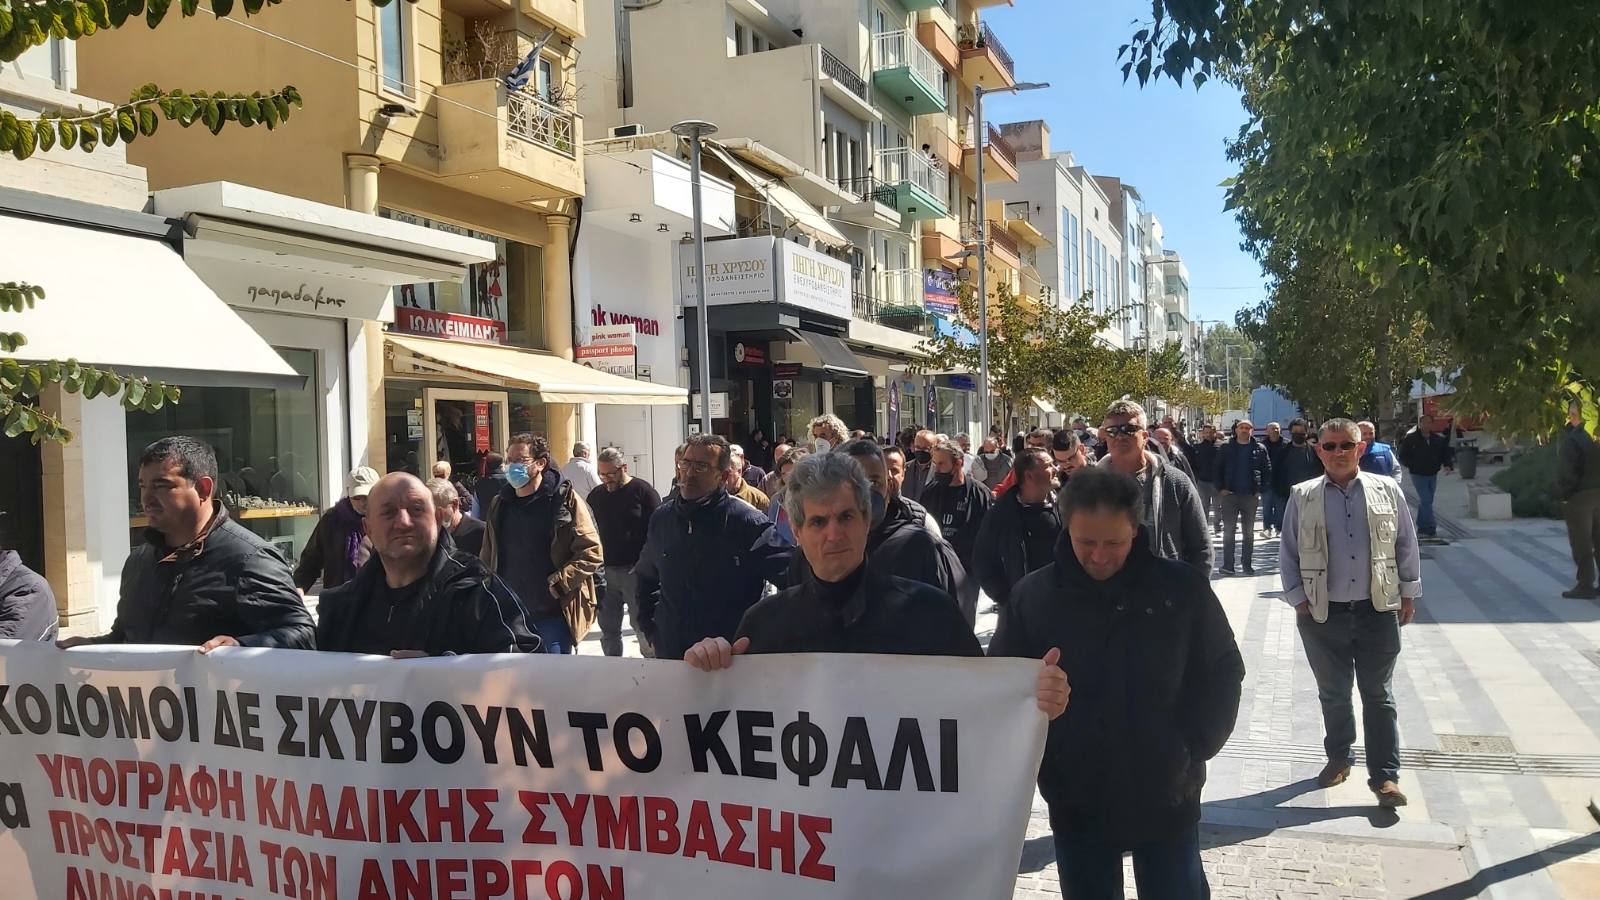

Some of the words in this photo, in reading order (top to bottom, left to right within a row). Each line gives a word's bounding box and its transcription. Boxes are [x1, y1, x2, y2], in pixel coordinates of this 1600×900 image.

[687, 264, 718, 276] ΠΓΗ
[722, 260, 766, 273] ΧΡΥΣΟΥ
[409, 315, 499, 340] ΙΩΑΚΕΙΜΙΔΗΣ
[592, 333, 606, 341] pink
[581, 347, 608, 355] passport
[610, 345, 633, 354] photos
[214, 690, 264, 752] ΔΕ
[276, 695, 555, 769] ΣΚΥΒΟΥΝ
[567, 711, 663, 774] ΤΟ
[683, 710, 959, 793] ΚΕΦΑΛΙ
[36, 753, 246, 822] ΥΠΟΓΡΑΦΗ
[255, 774, 504, 843] ΚΛΑΔΙΚΗΣ
[518, 790, 835, 882] ΣΥΜΒΑΣΗΣ
[48, 810, 254, 887] ΠΡΟΣΤΑΣΙΑ
[260, 840, 337, 900] ΤΩΝ
[356, 859, 625, 900] ΑΝΕΡΓΩΝ
